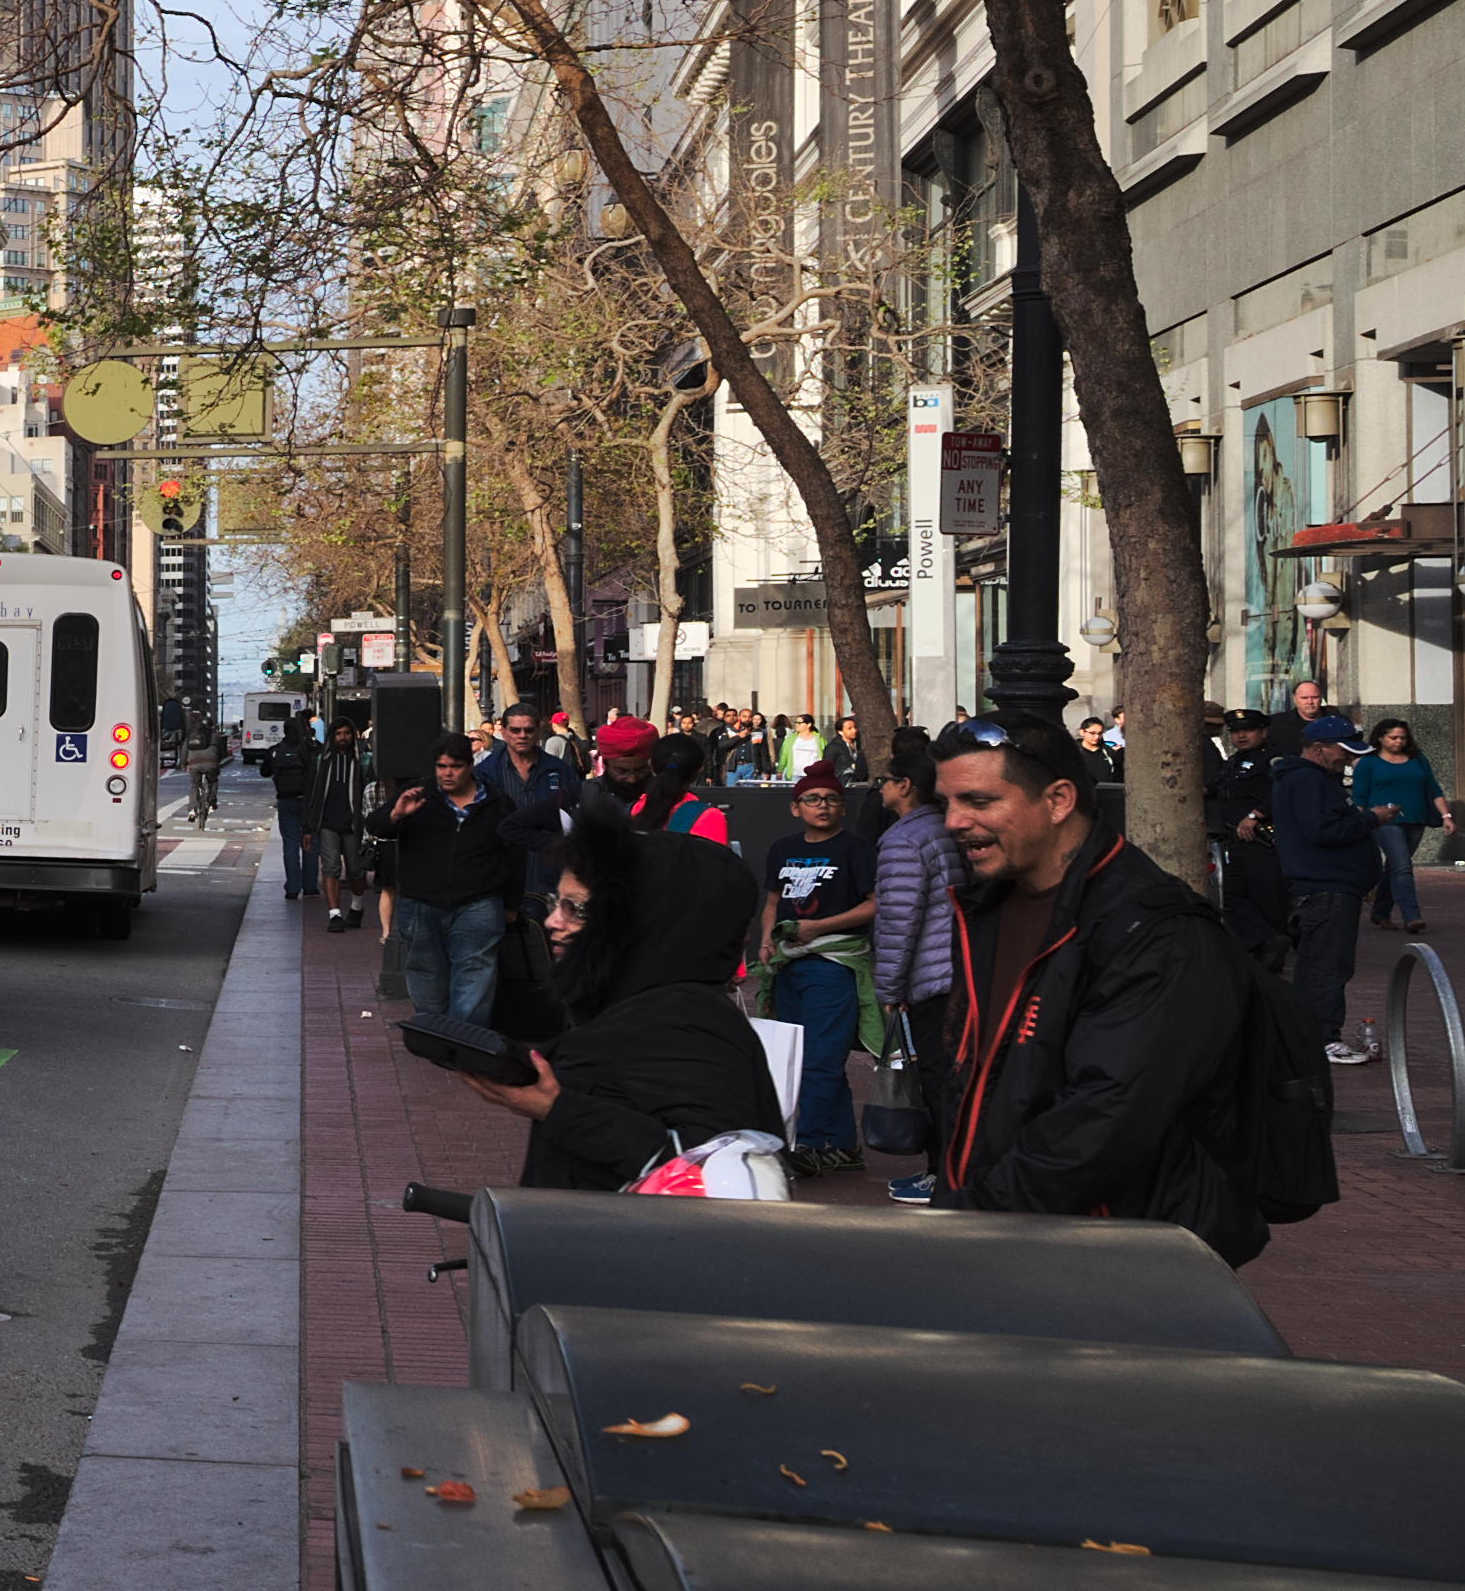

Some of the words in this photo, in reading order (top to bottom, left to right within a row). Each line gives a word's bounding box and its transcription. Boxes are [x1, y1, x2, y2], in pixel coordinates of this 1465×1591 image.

[846, 96, 875, 225] CENTURY
[951, 436, 992, 448] TOW-AWAY
[943, 449, 960, 469] NO
[962, 455, 999, 470] STOPPING
[958, 480, 984, 494] ANY
[955, 498, 985, 513] TIME
[915, 519, 933, 579] Powell
